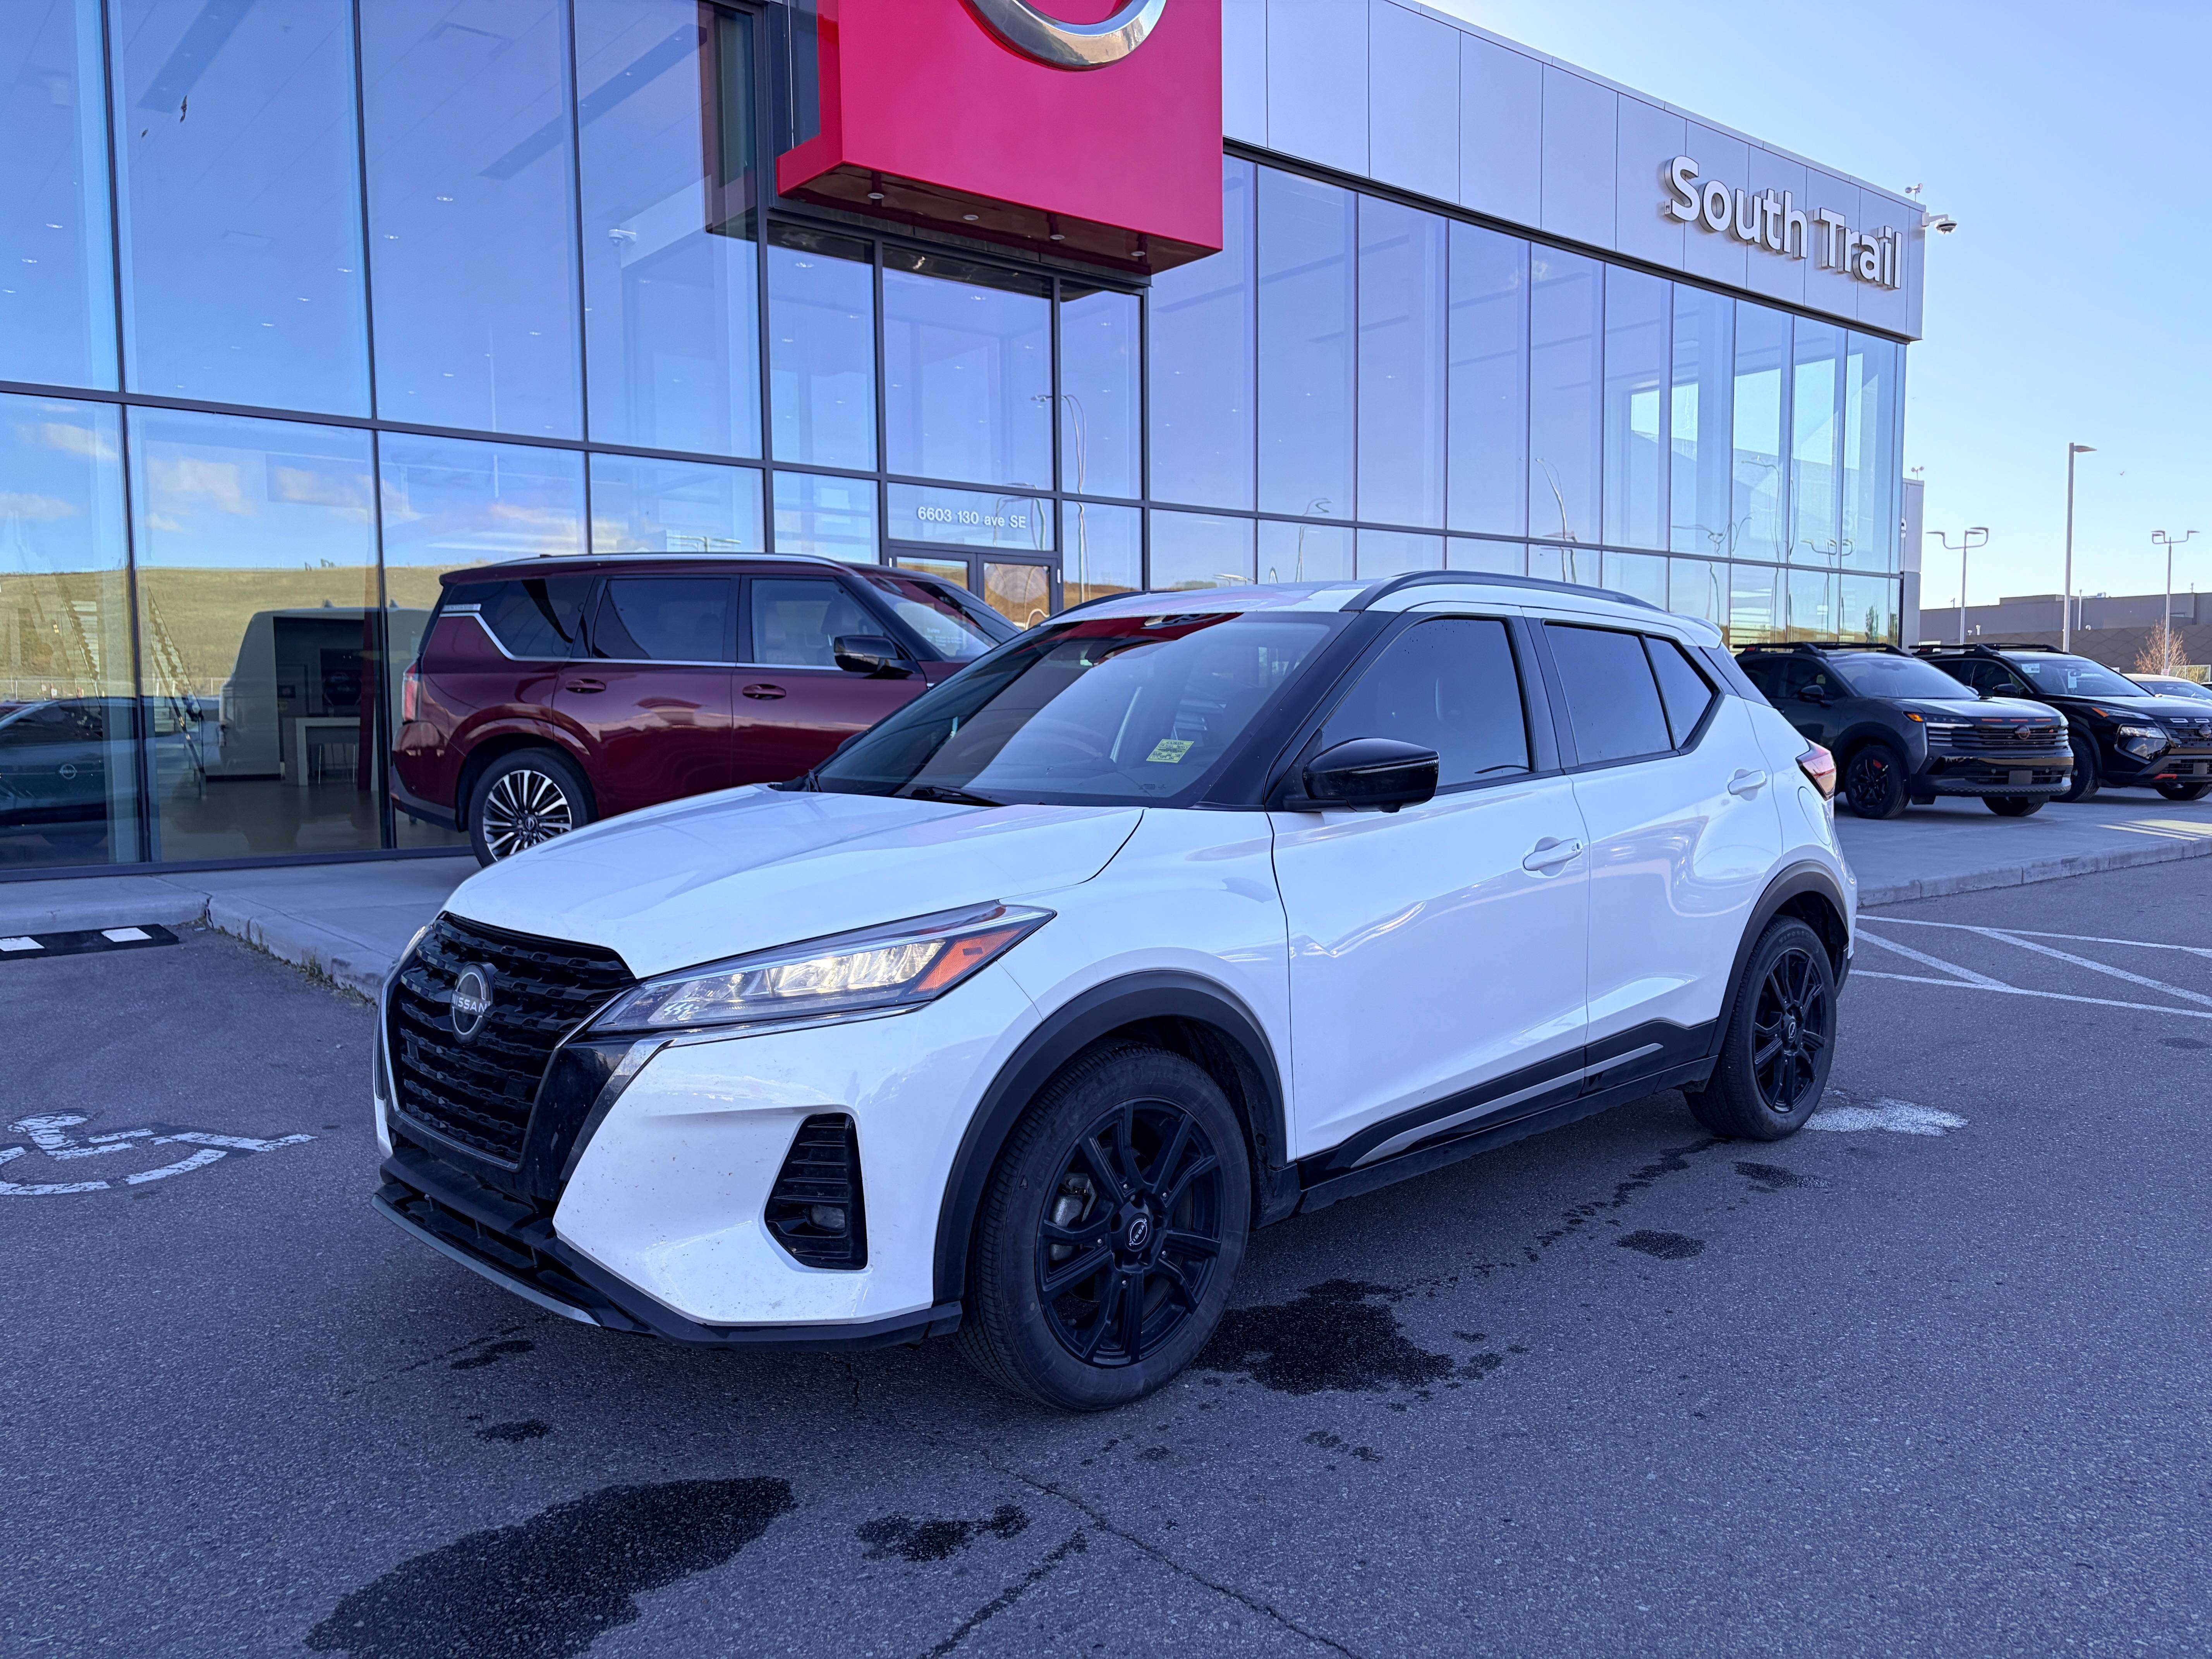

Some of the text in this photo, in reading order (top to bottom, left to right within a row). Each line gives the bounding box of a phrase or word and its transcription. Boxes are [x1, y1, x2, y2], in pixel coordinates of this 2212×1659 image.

[1665, 156, 1903, 289] South Trail
[917, 506, 1026, 528] 6603 130 ave SE
[452, 993, 488, 1013] NISSAN
